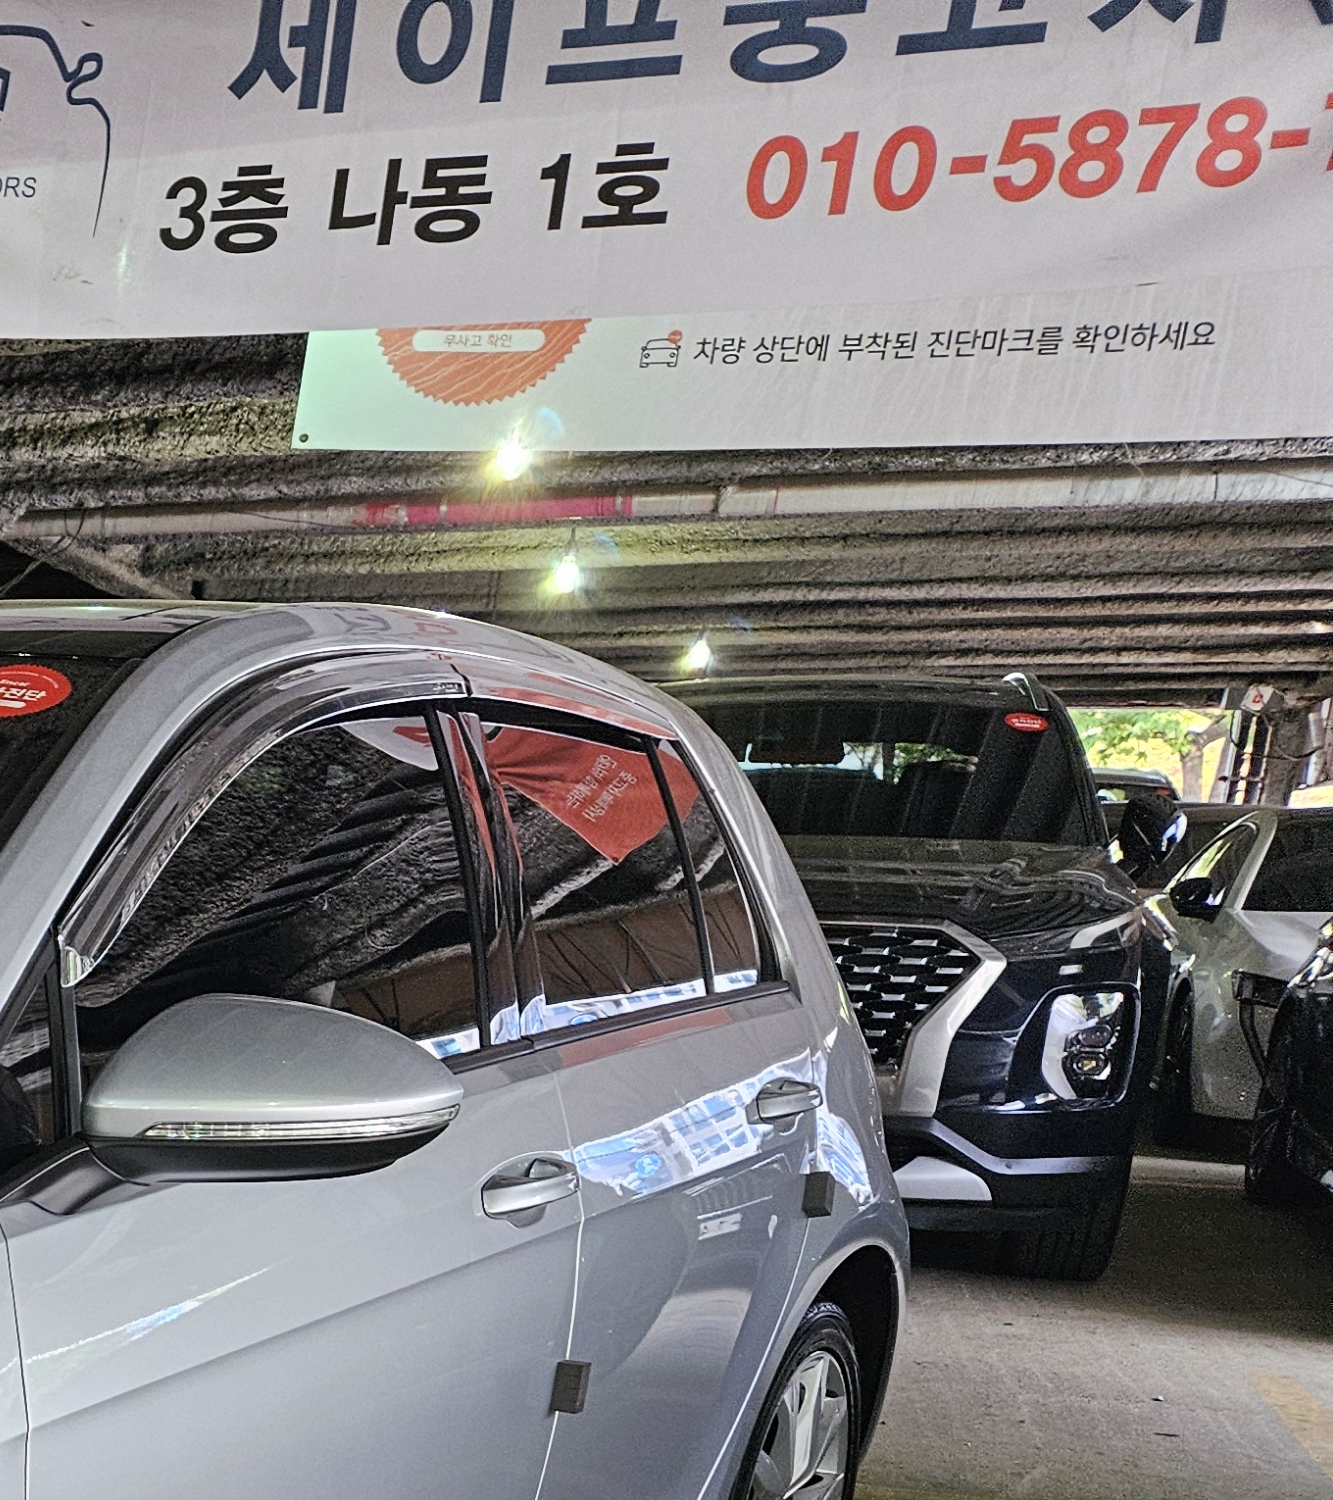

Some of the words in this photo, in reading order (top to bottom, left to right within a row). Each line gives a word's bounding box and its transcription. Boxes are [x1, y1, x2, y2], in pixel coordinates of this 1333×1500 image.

[227, 0, 1333, 114] 세이프중
[159, 164, 288, 254] 3층
[328, 155, 493, 245] 나동
[539, 141, 670, 231] 1호
[486, 333, 513, 348] 확인
[693, 335, 746, 365] 차량
[752, 333, 831, 364] 상단에
[838, 330, 918, 362] 부착된
[927, 326, 1064, 358] 진단마크를
[1072, 320, 1217, 353] 확인하세요
